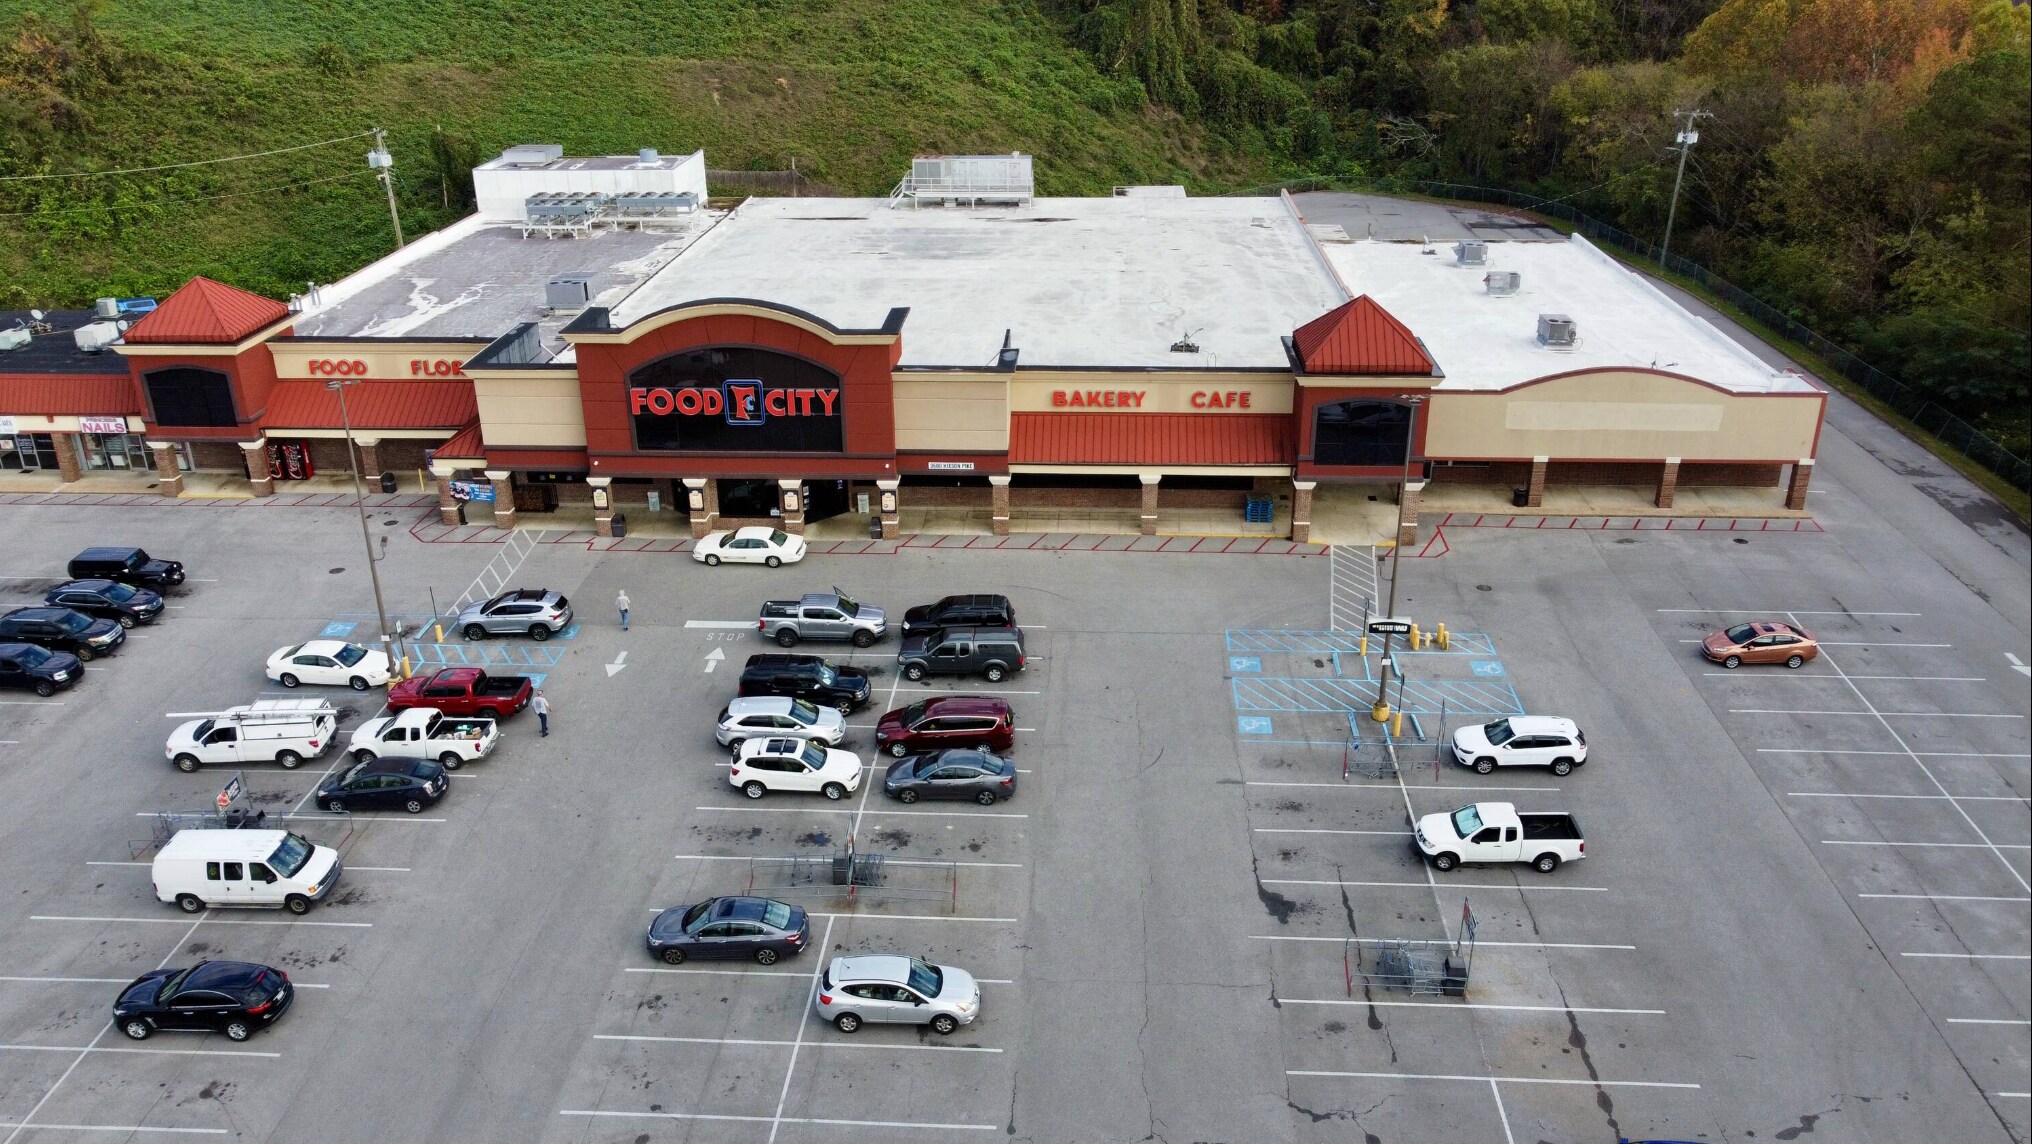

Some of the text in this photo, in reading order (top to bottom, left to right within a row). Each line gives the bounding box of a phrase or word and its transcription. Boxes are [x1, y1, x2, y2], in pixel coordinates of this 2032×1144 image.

[308, 359, 368, 376] FOOD
[629, 387, 840, 417] FOOD CITY
[1052, 390, 1252, 409] BAKERY CAFE
[82, 423, 125, 433] NAILS
[707, 633, 745, 641] STOP
